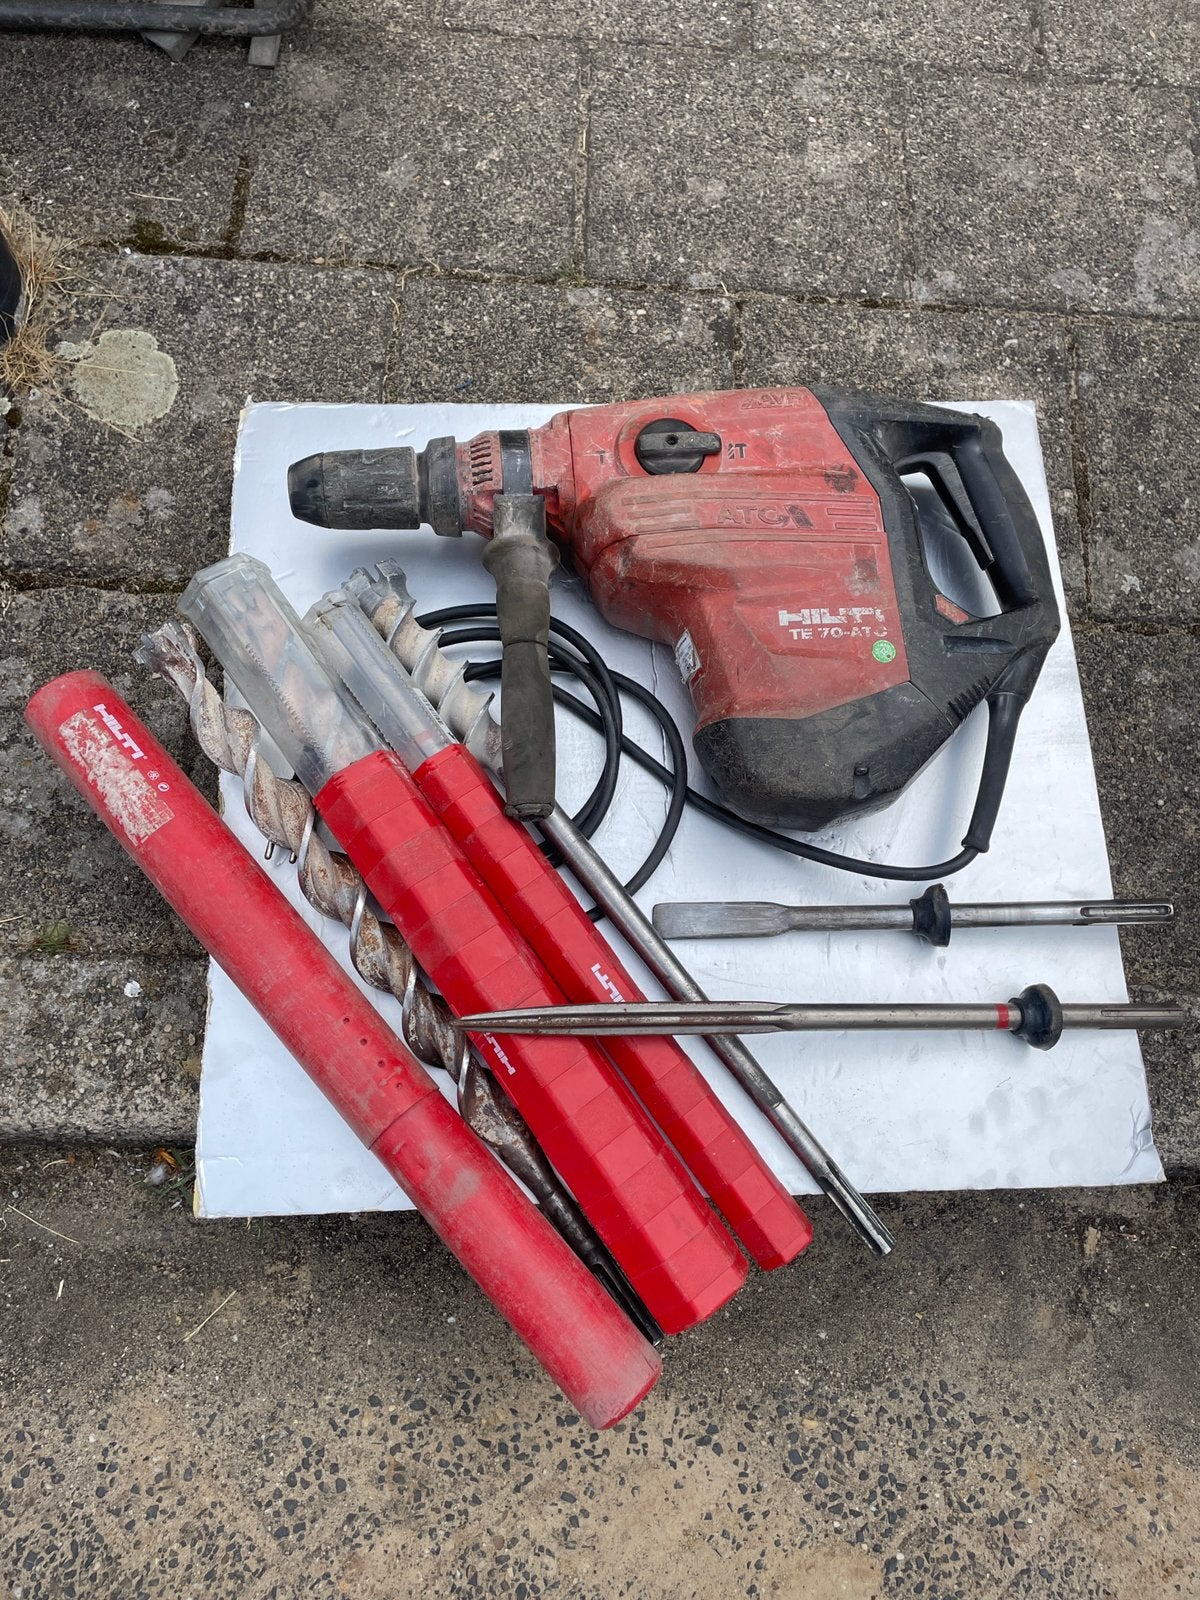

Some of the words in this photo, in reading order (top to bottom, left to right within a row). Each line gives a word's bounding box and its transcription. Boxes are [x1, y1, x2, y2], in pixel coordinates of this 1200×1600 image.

[778, 607, 885, 626] HILTI
[789, 628, 812, 640] TE
[93, 704, 145, 759] HILTI
[591, 963, 626, 1003] ILTI
[483, 1032, 516, 1075] HIL
